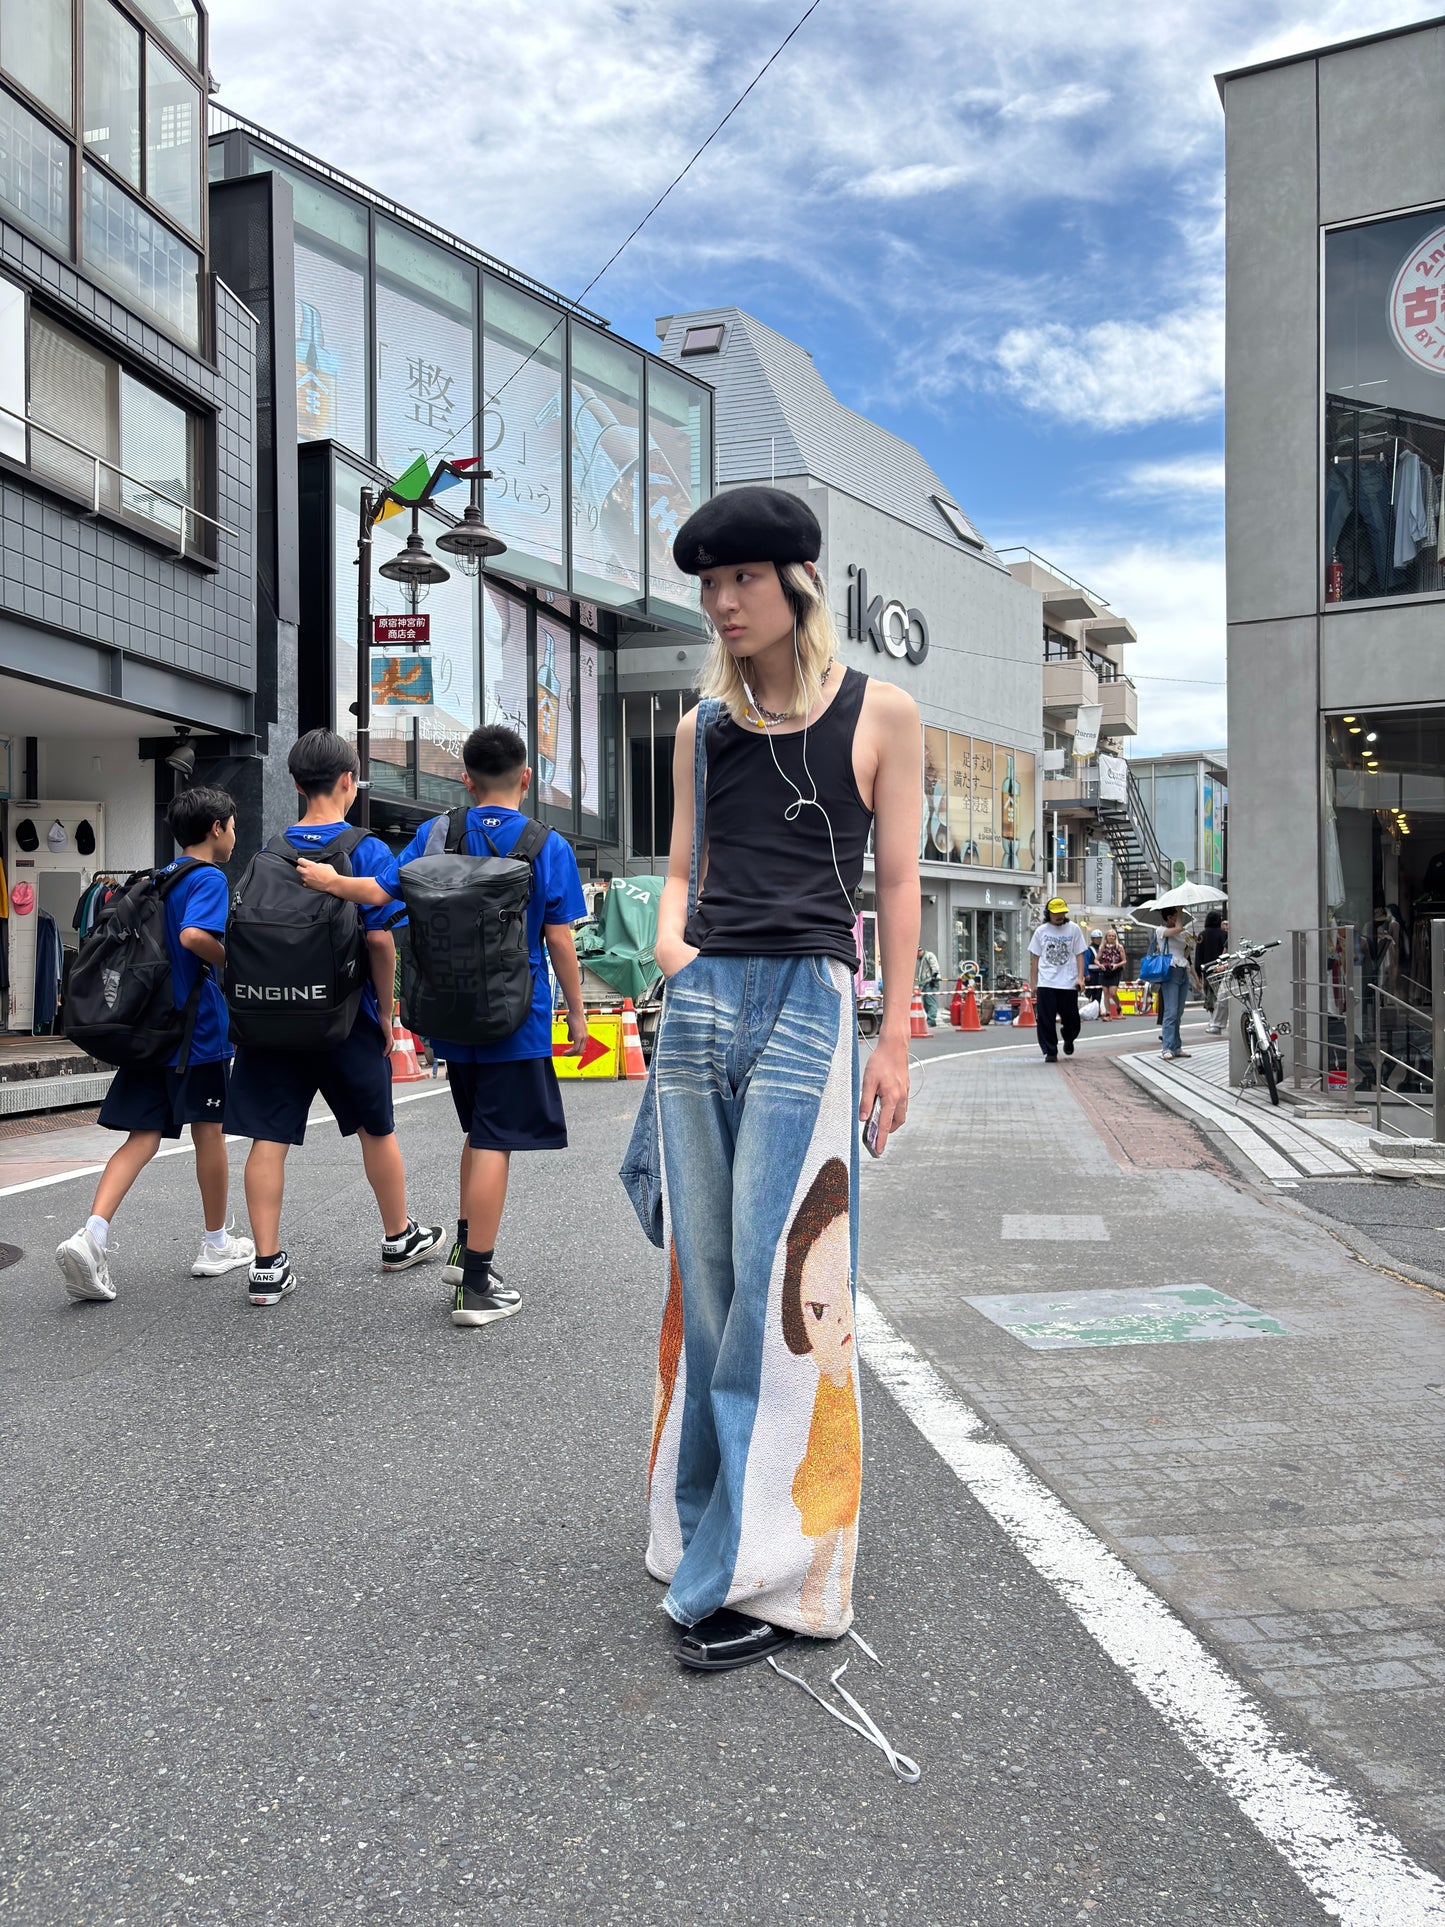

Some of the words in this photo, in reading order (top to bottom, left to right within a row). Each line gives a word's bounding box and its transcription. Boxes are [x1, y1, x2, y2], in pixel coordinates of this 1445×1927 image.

[1415, 243, 1445, 277] 2n
[1414, 328, 1437, 349] BY
[379, 618, 426, 629] 原宿神宮前
[388, 629, 416, 639] 商店会
[235, 983, 327, 1001] ENGINE
[252, 1272, 275, 1282] VANS
